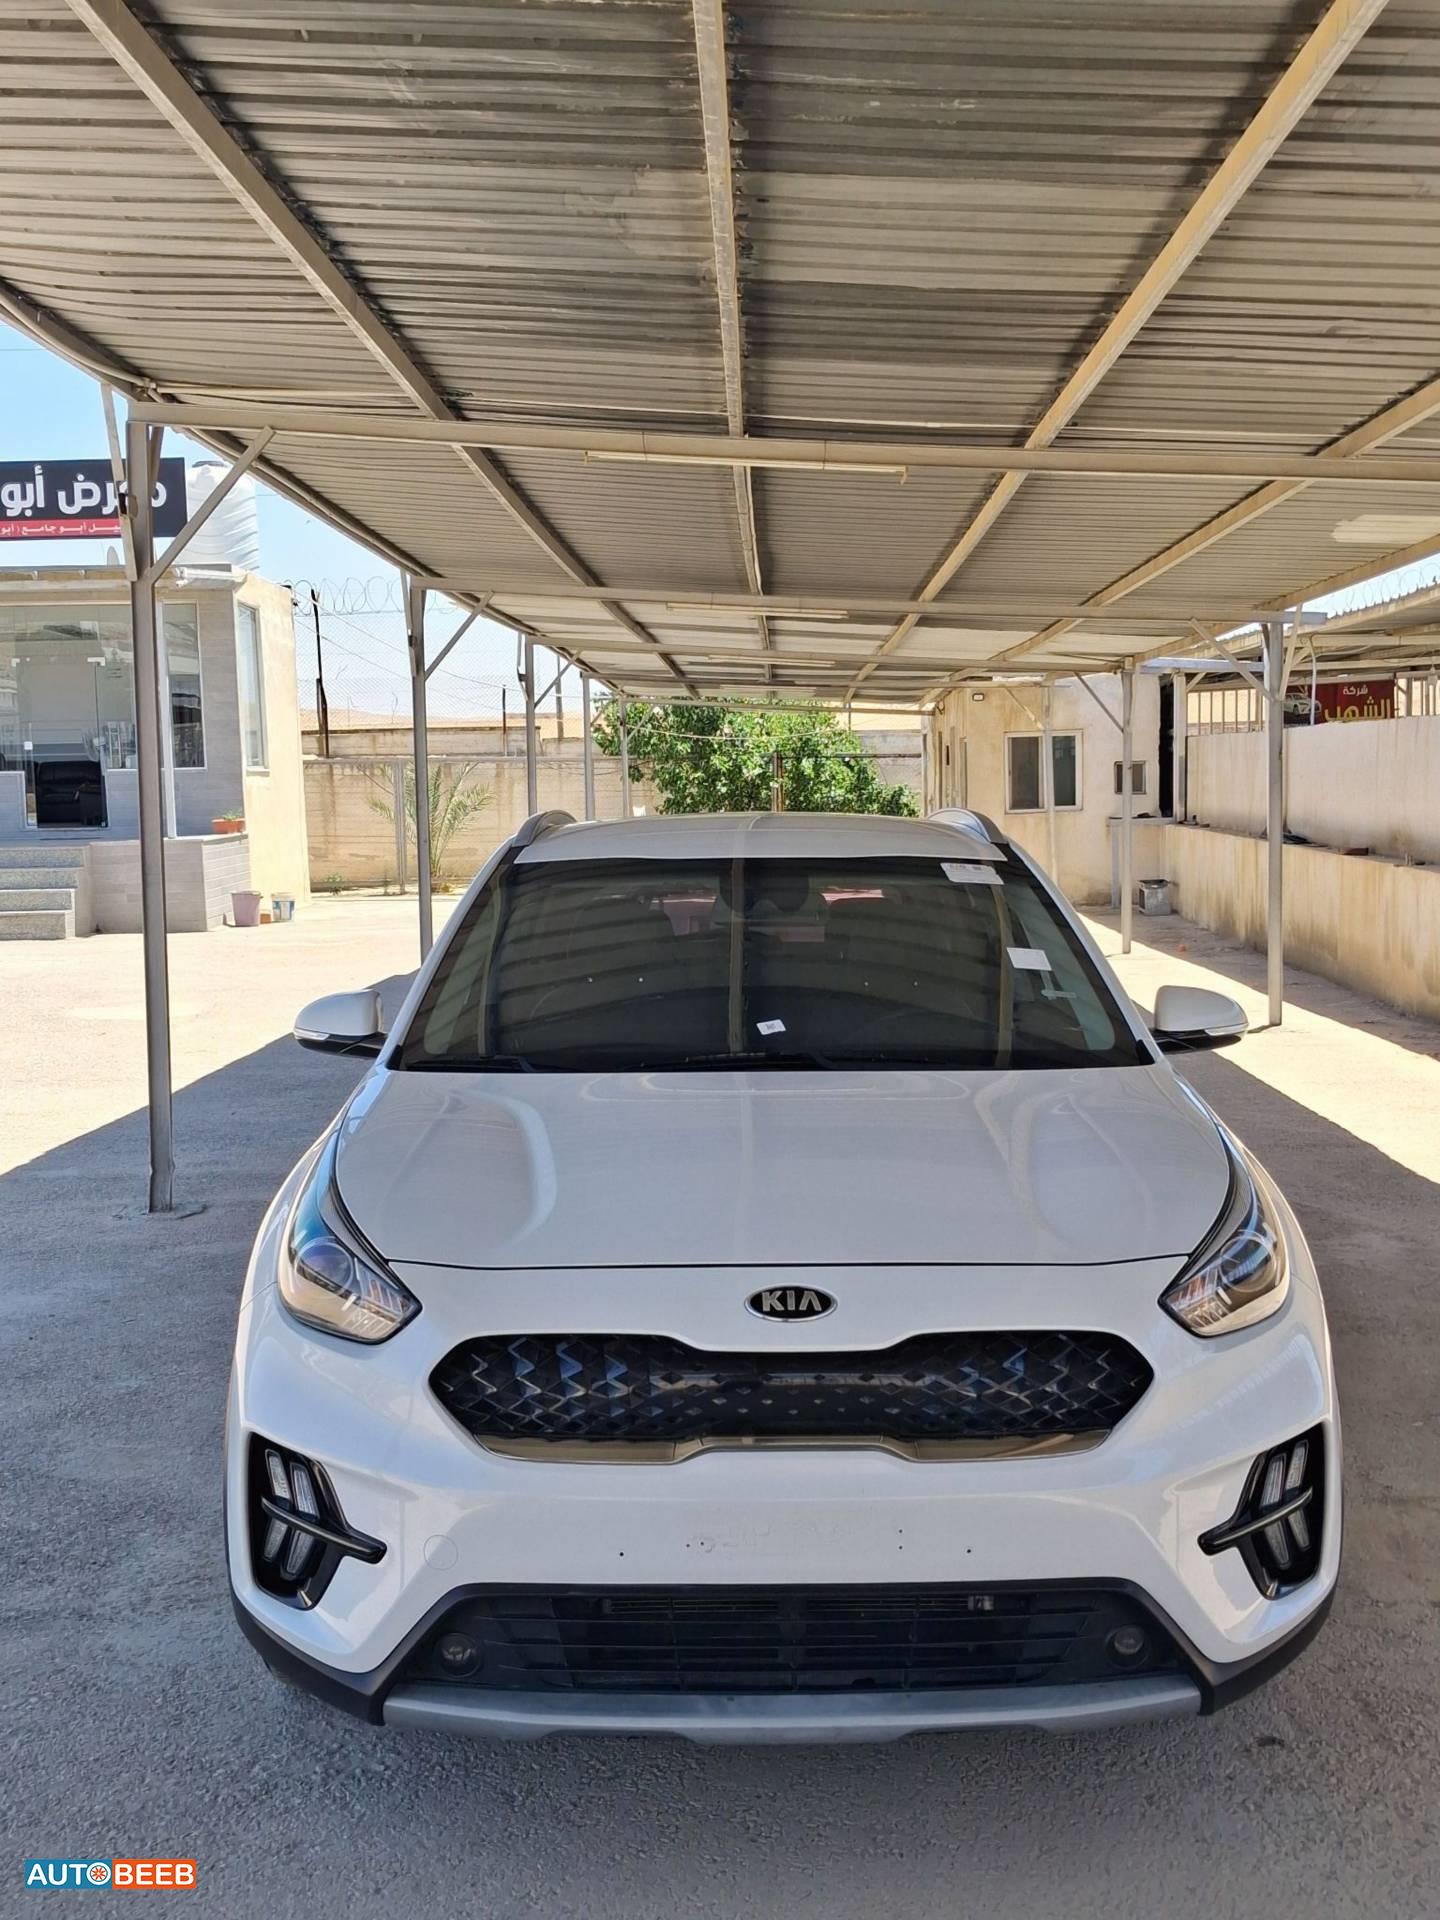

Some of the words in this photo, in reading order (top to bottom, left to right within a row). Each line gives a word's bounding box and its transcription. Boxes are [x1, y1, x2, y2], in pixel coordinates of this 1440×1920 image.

[1, 464, 46, 517] أبو
[57, 473, 167, 514] مرض
[1342, 684, 1369, 696] شركة
[761, 1289, 823, 1312] KIA
